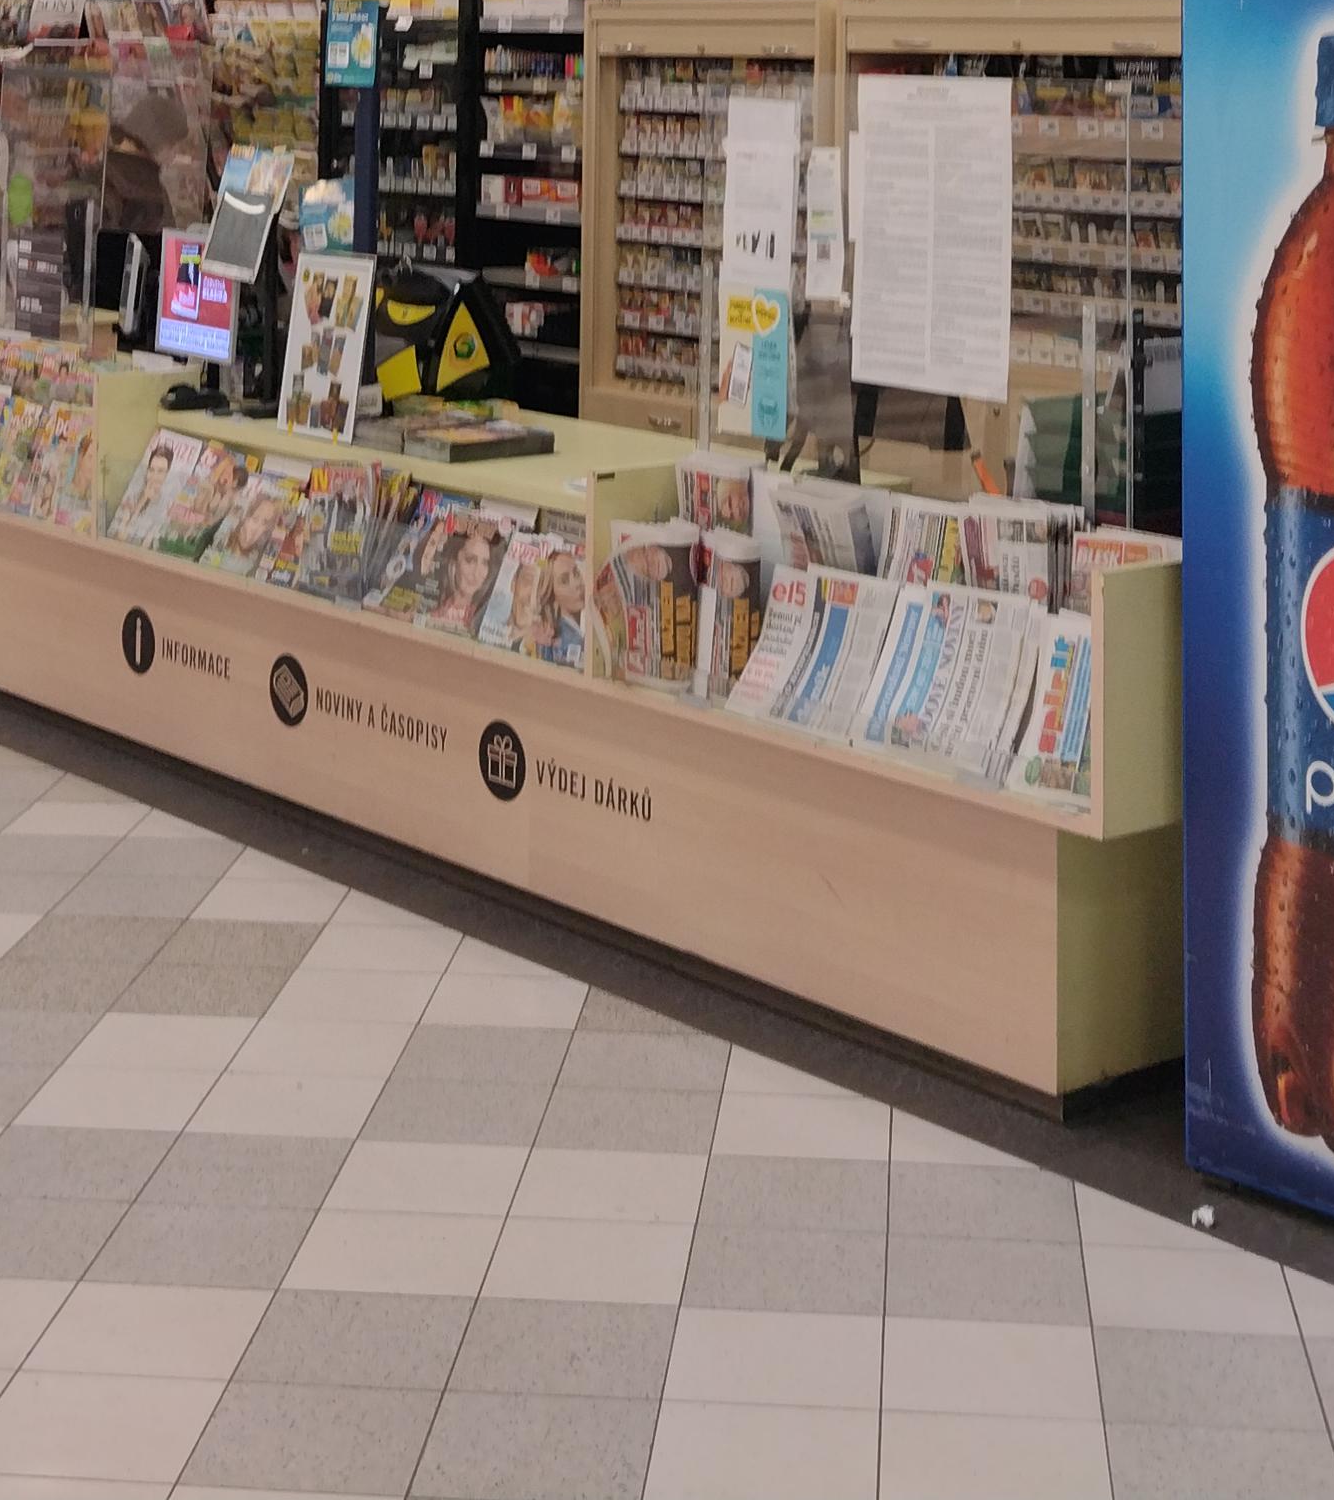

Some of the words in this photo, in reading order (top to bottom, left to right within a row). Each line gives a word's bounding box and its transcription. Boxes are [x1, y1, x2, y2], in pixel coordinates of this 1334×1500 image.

[162, 637, 231, 681] INFORMACE
[316, 687, 363, 723] NOVINY
[367, 705, 376, 727] A
[381, 702, 448, 752] ČASOPISY
[536, 757, 587, 800] VÝDEJ
[595, 776, 652, 822] DÁRKŮ
